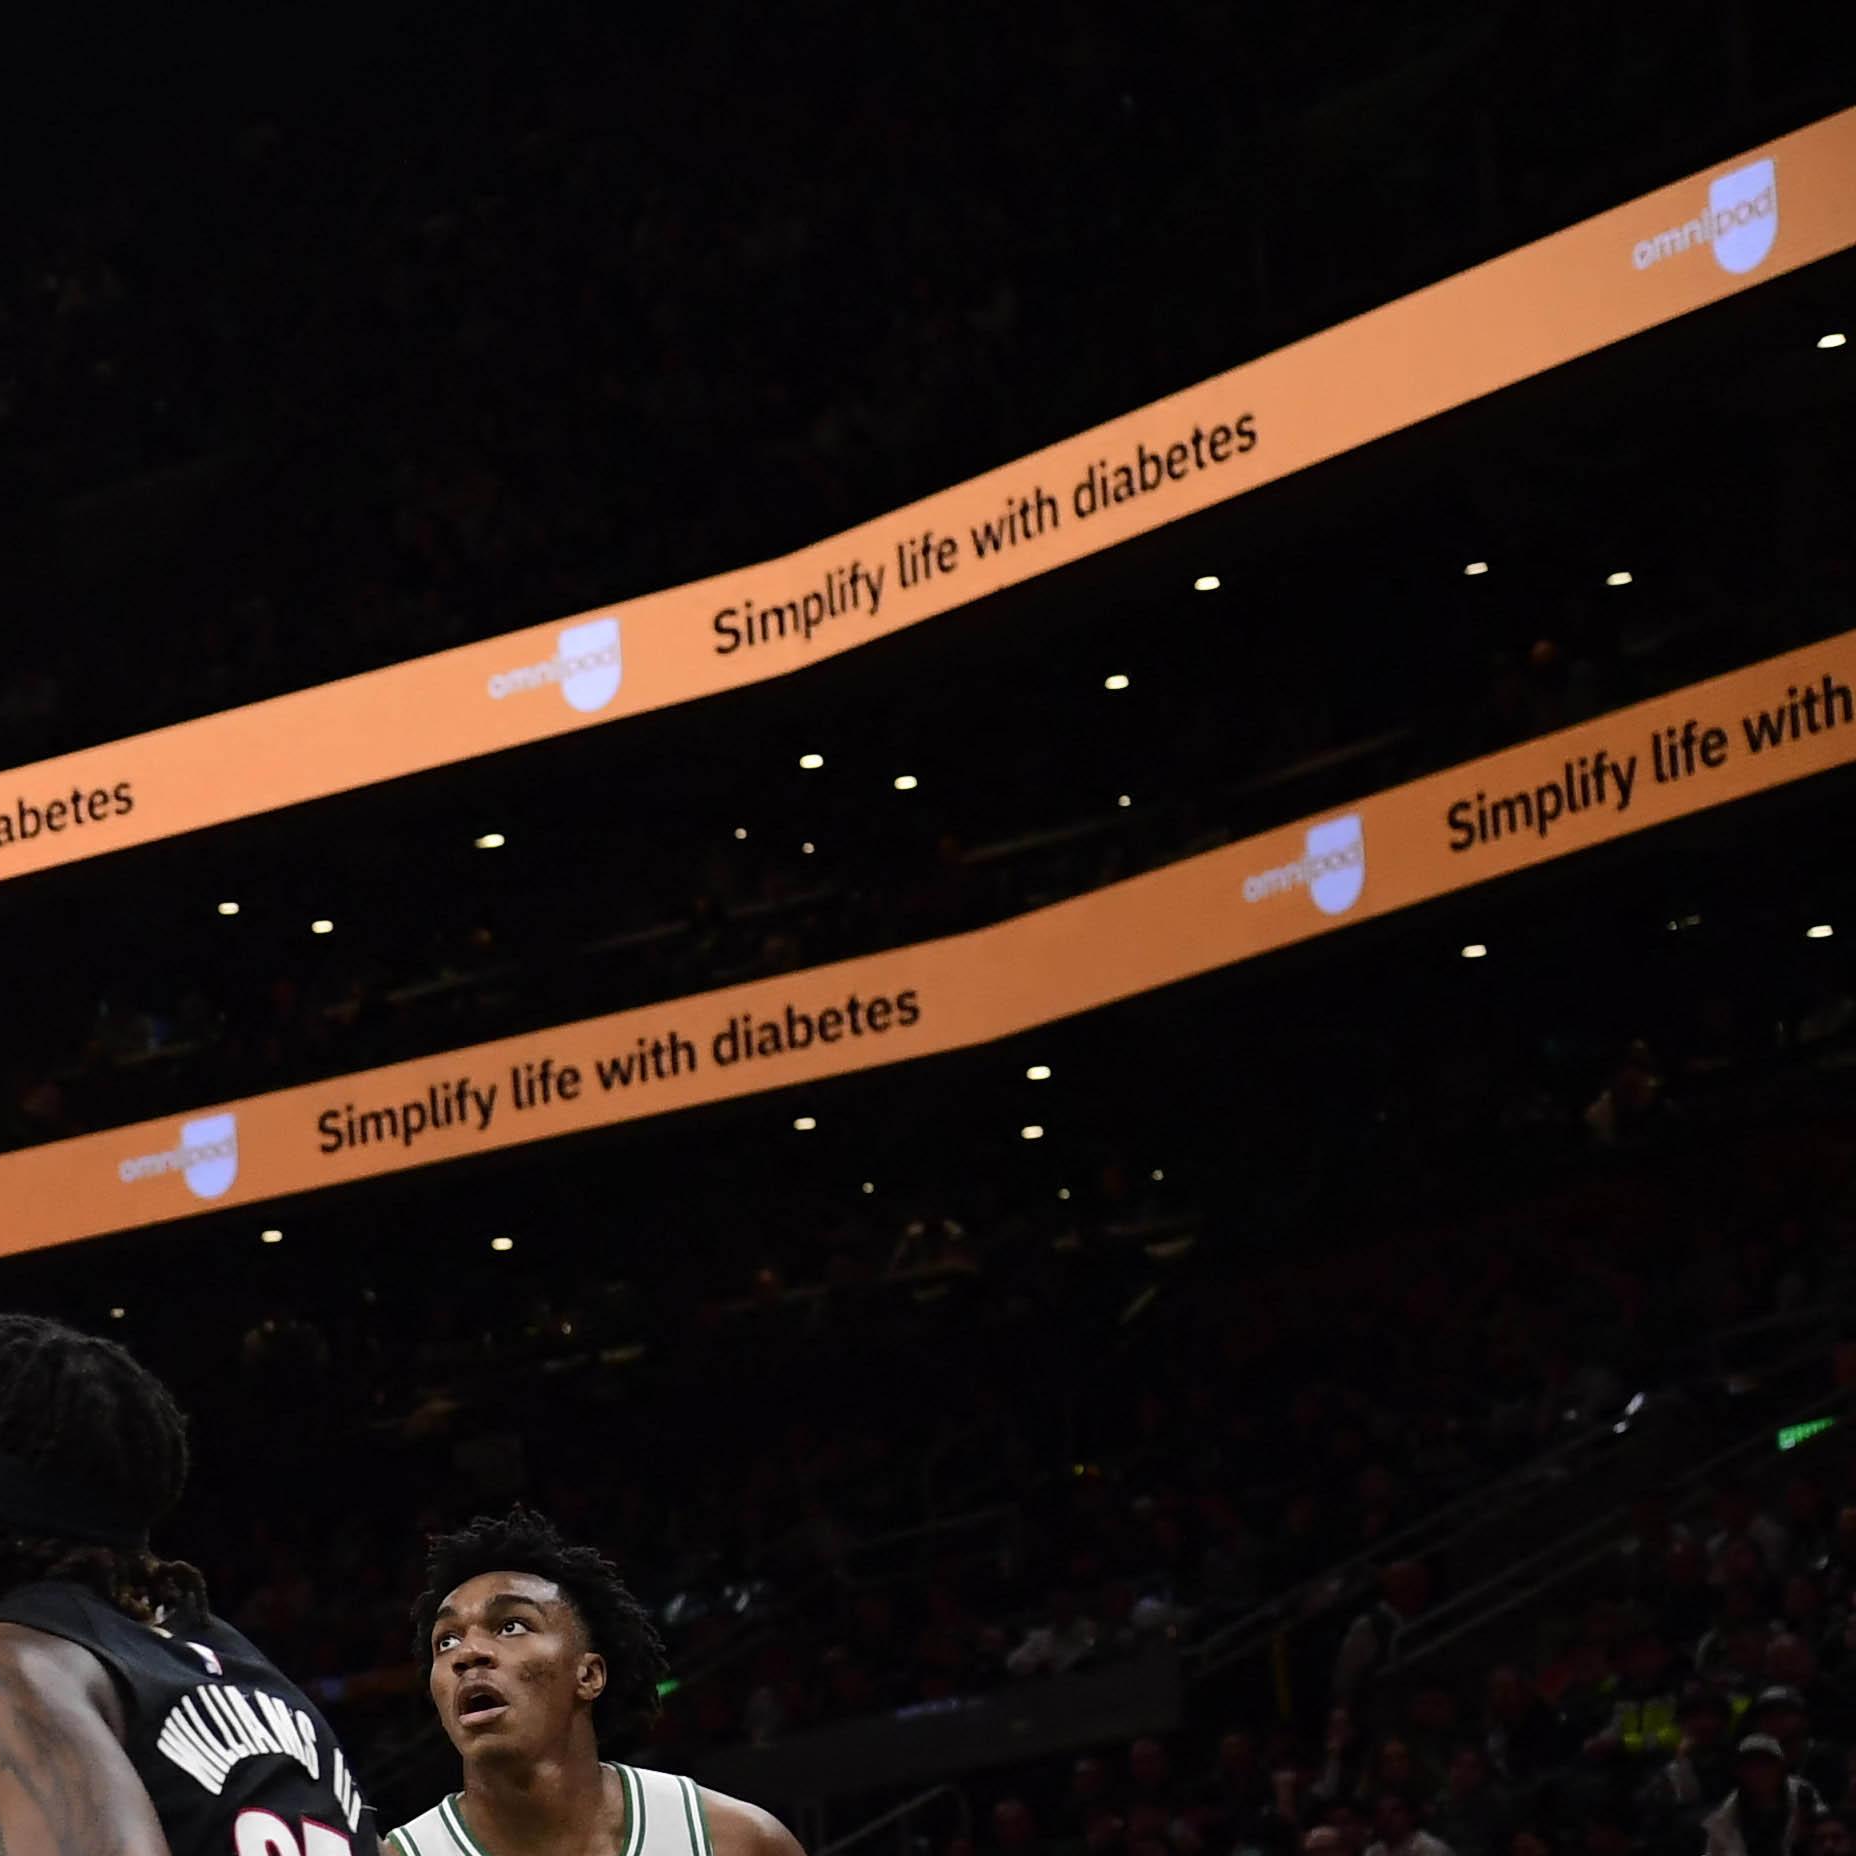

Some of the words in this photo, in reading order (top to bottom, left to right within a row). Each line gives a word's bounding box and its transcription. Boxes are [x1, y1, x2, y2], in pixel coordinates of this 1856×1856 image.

[1632, 182, 1775, 268] omnipod
[713, 562, 884, 654] Simplify
[898, 533, 958, 589] life
[971, 488, 1059, 559] with
[1073, 414, 1257, 519] diabetes
[1447, 750, 1637, 853] Simplify
[1652, 720, 1728, 784] life
[1742, 674, 1854, 754] with
[318, 1078, 497, 1154] Simplify
[511, 1059, 582, 1110] life
[596, 1032, 697, 1091] with
[712, 990, 920, 1067] diabetes
[156, 1683, 319, 1796] WILLIAMS
